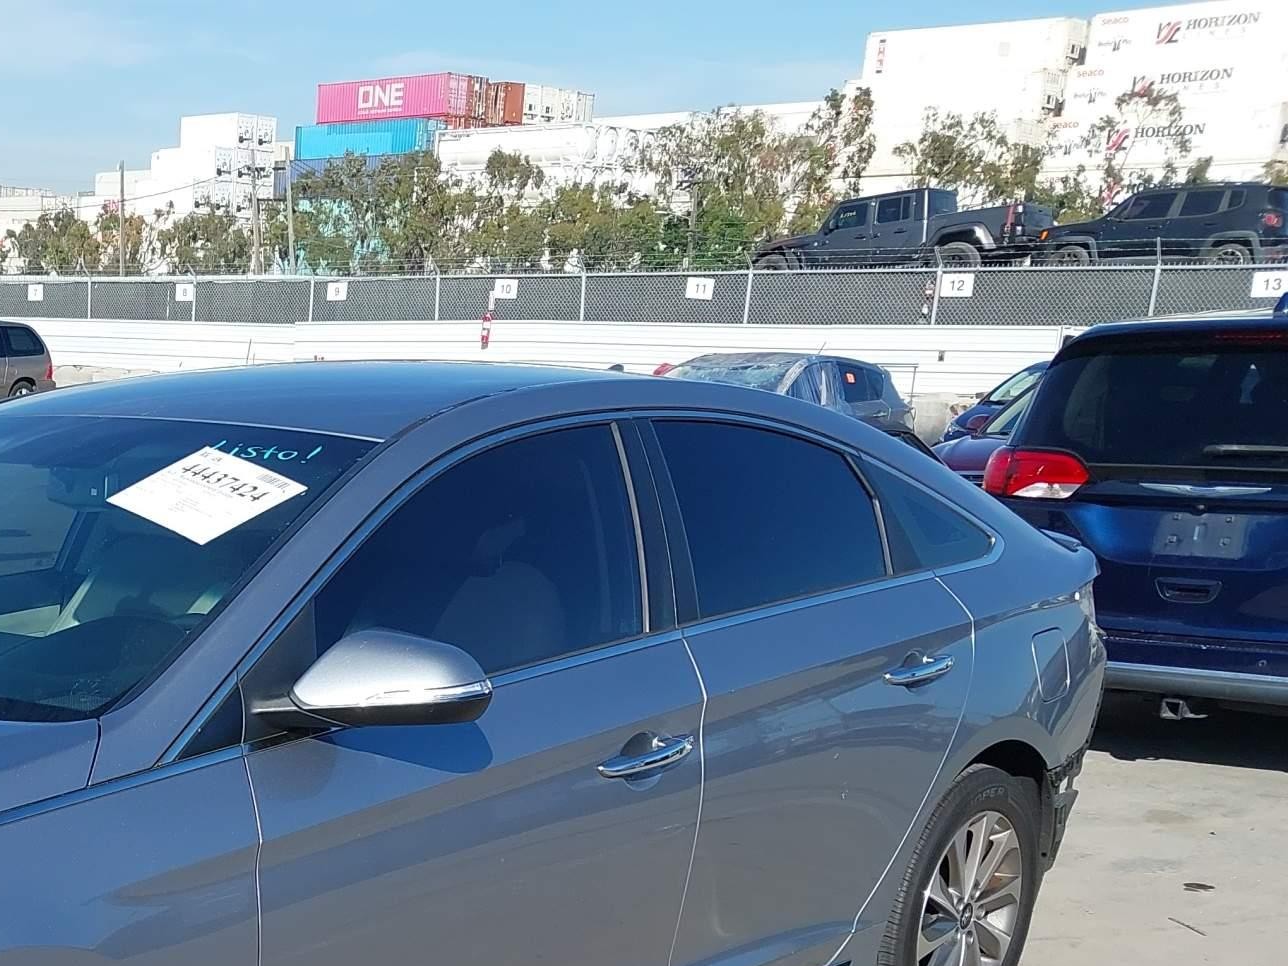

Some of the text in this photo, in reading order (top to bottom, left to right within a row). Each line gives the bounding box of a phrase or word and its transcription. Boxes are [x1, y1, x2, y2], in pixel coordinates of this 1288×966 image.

[1101, 16, 1129, 25] seaco
[1185, 11, 1261, 31] HORIZON
[1076, 69, 1105, 78] seaco
[1158, 67, 1235, 85] HORIZON
[357, 82, 405, 109] ONE
[500, 284, 512, 294] 10
[695, 283, 707, 295] 11
[949, 279, 966, 291] 12
[1263, 278, 1282, 291] 13
[181, 463, 272, 502] 44437424
